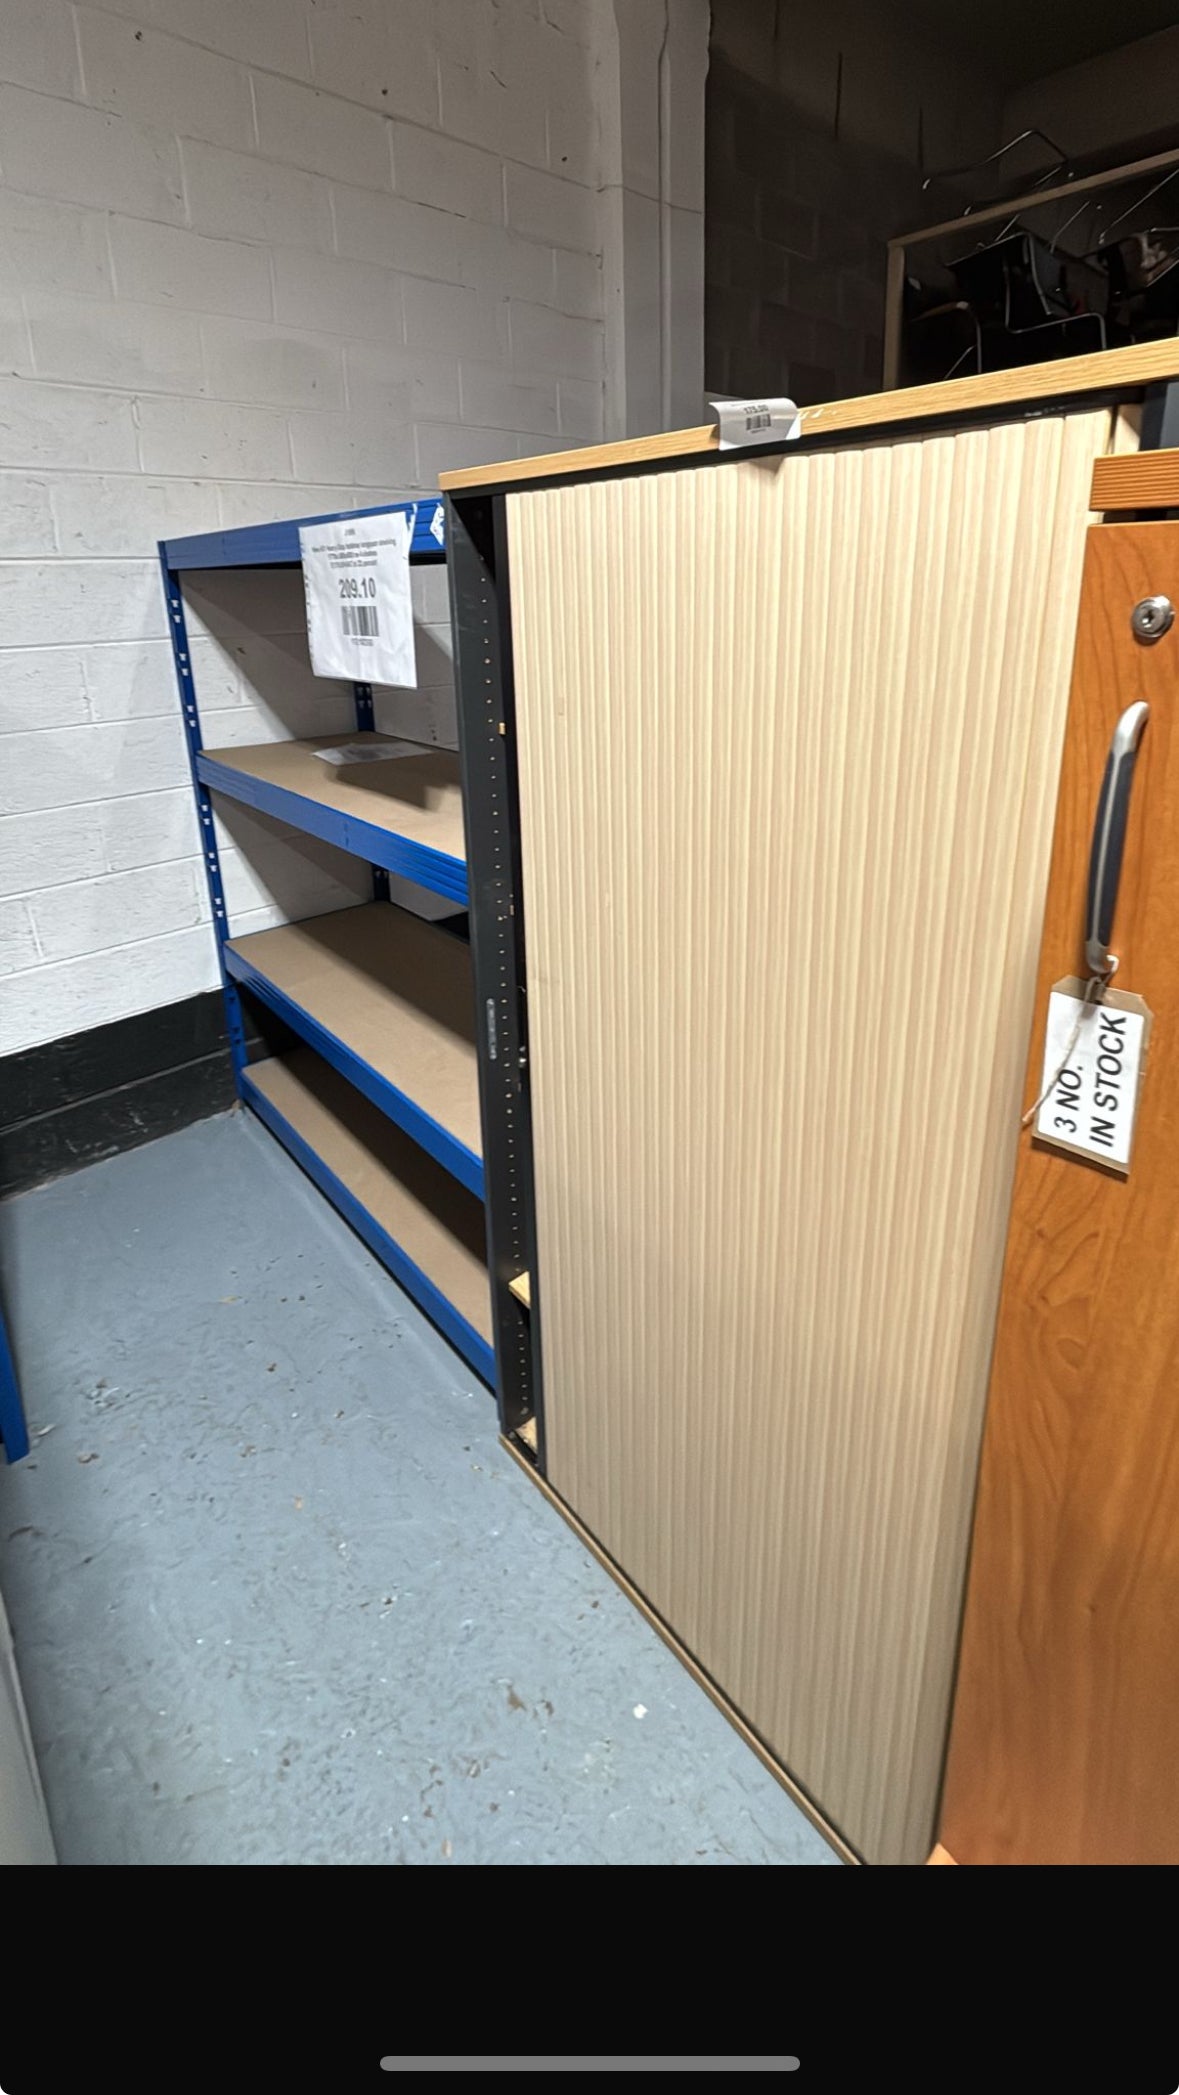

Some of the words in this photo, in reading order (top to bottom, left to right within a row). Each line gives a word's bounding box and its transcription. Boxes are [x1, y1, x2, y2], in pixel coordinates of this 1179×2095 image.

[339, 577, 376, 599] 209.10
[1093, 1012, 1127, 1112] STOCK
[1056, 1065, 1083, 1111] NO.
[1053, 1116, 1077, 1133] 3
[1089, 1116, 1116, 1147] IN
